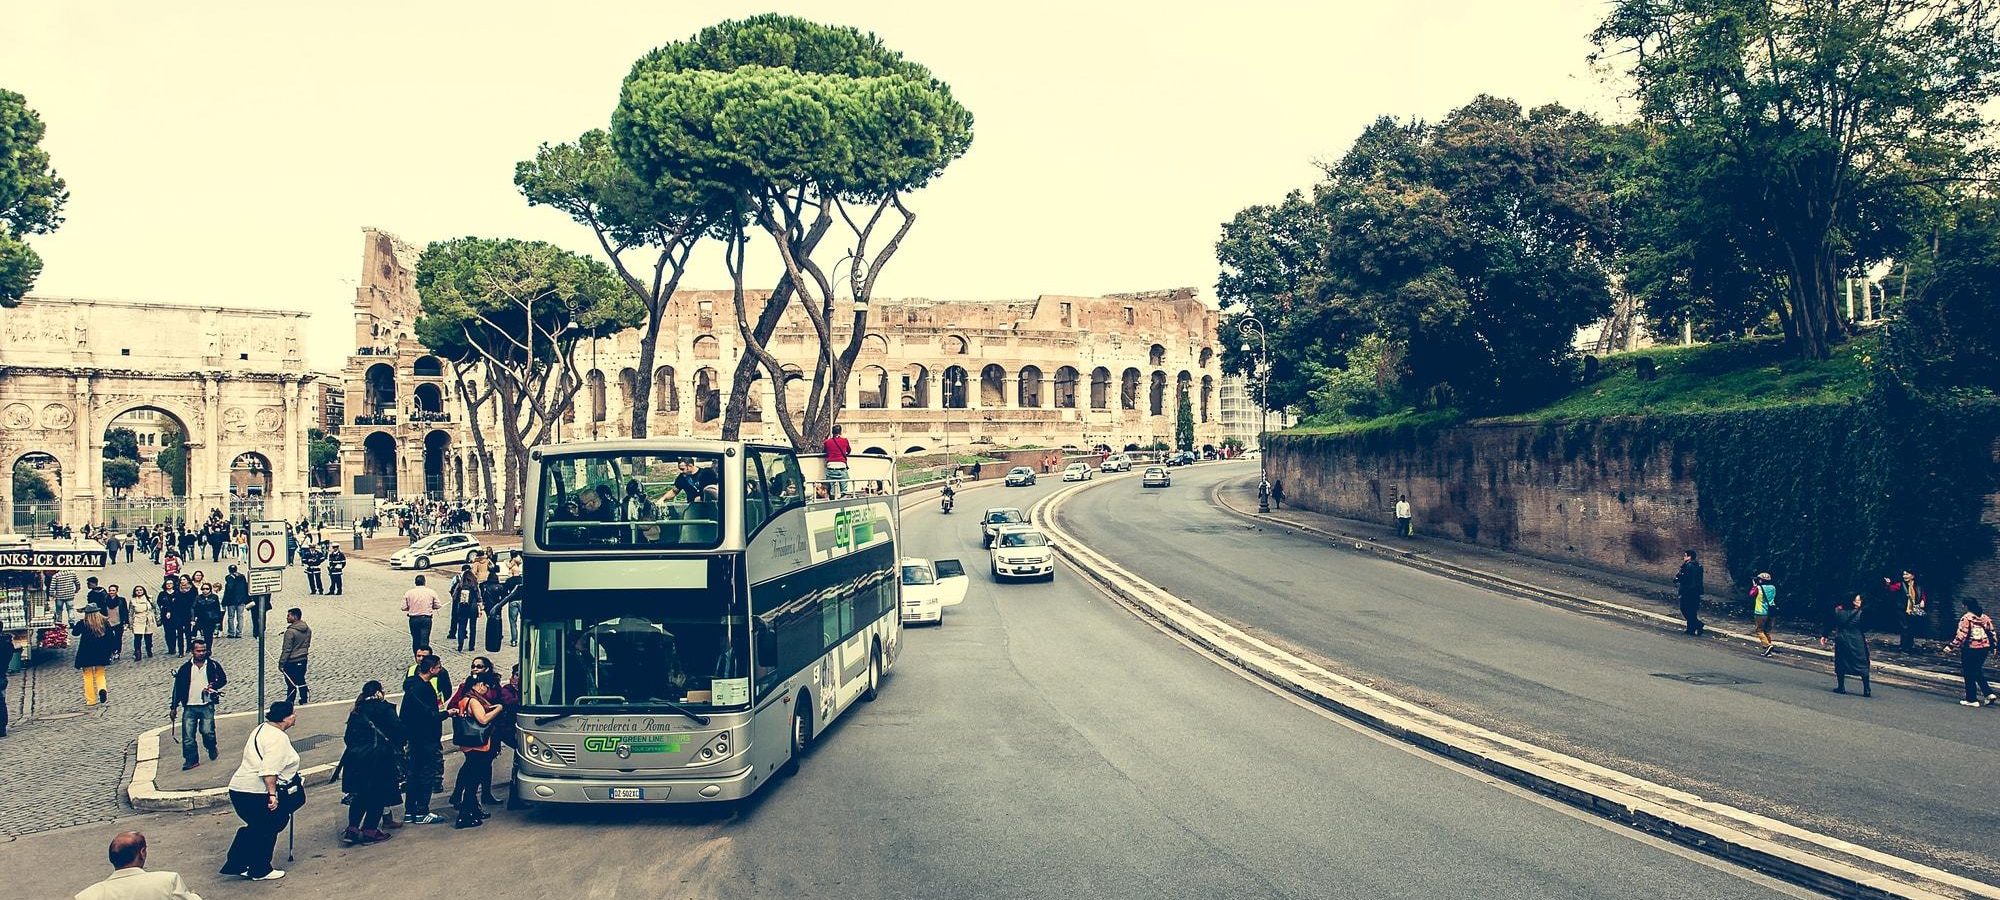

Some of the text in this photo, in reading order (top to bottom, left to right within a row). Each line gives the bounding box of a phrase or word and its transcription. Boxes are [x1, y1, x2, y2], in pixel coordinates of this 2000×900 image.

[33, 553, 55, 566] ICE
[56, 553, 101, 566] CREAM
[576, 717, 671, 732] Arrivederci a Roma
[584, 736, 621, 752] GLT
[623, 735, 647, 743] GREEN
[648, 735, 664, 743] LINE
